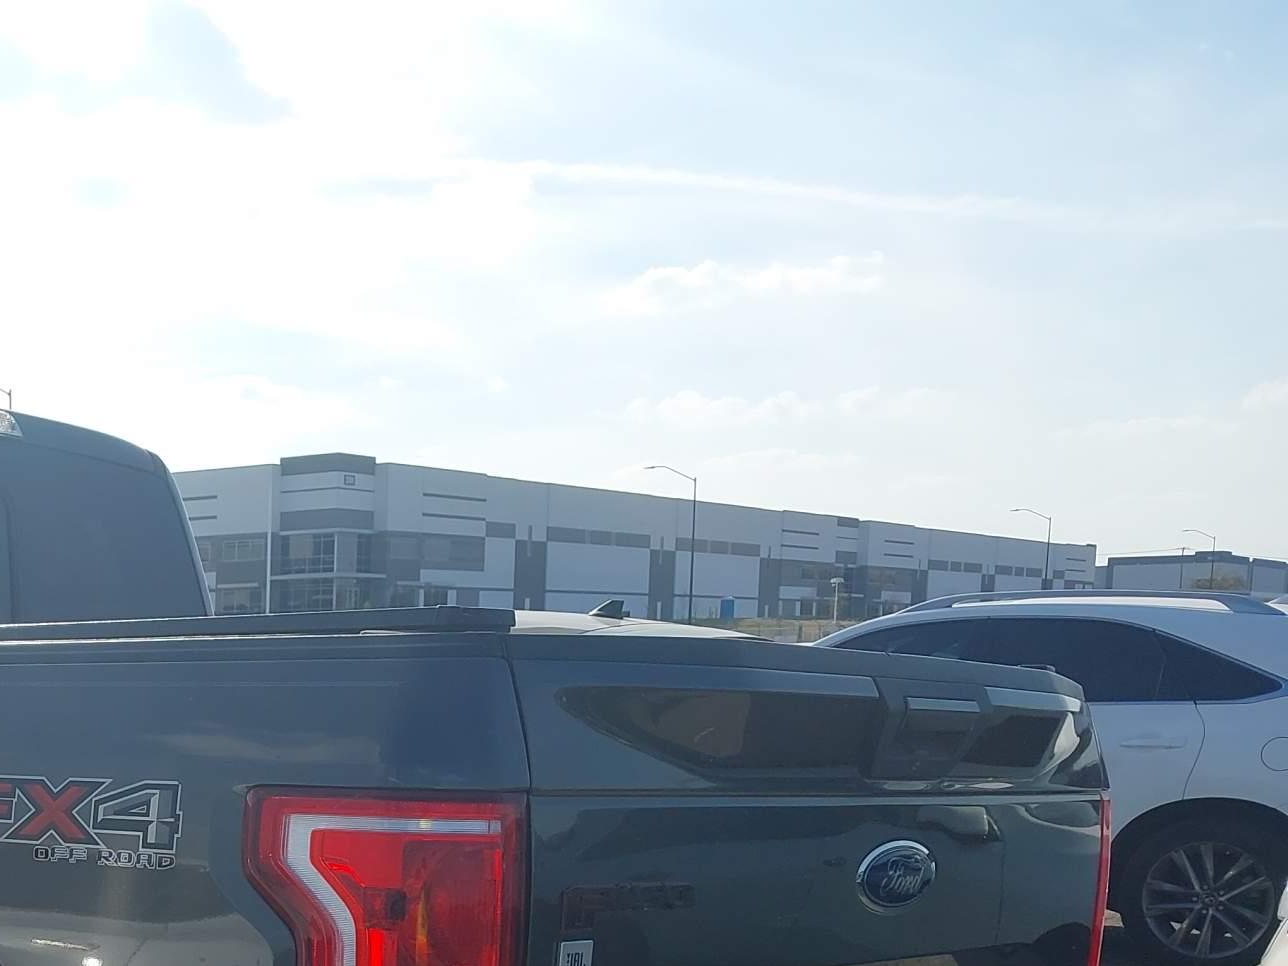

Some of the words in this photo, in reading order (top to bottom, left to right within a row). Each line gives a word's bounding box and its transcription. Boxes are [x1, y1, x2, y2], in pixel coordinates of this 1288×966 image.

[32, 846, 88, 864] OFF
[96, 849, 177, 870] ROAD
[879, 852, 924, 896] Ford
